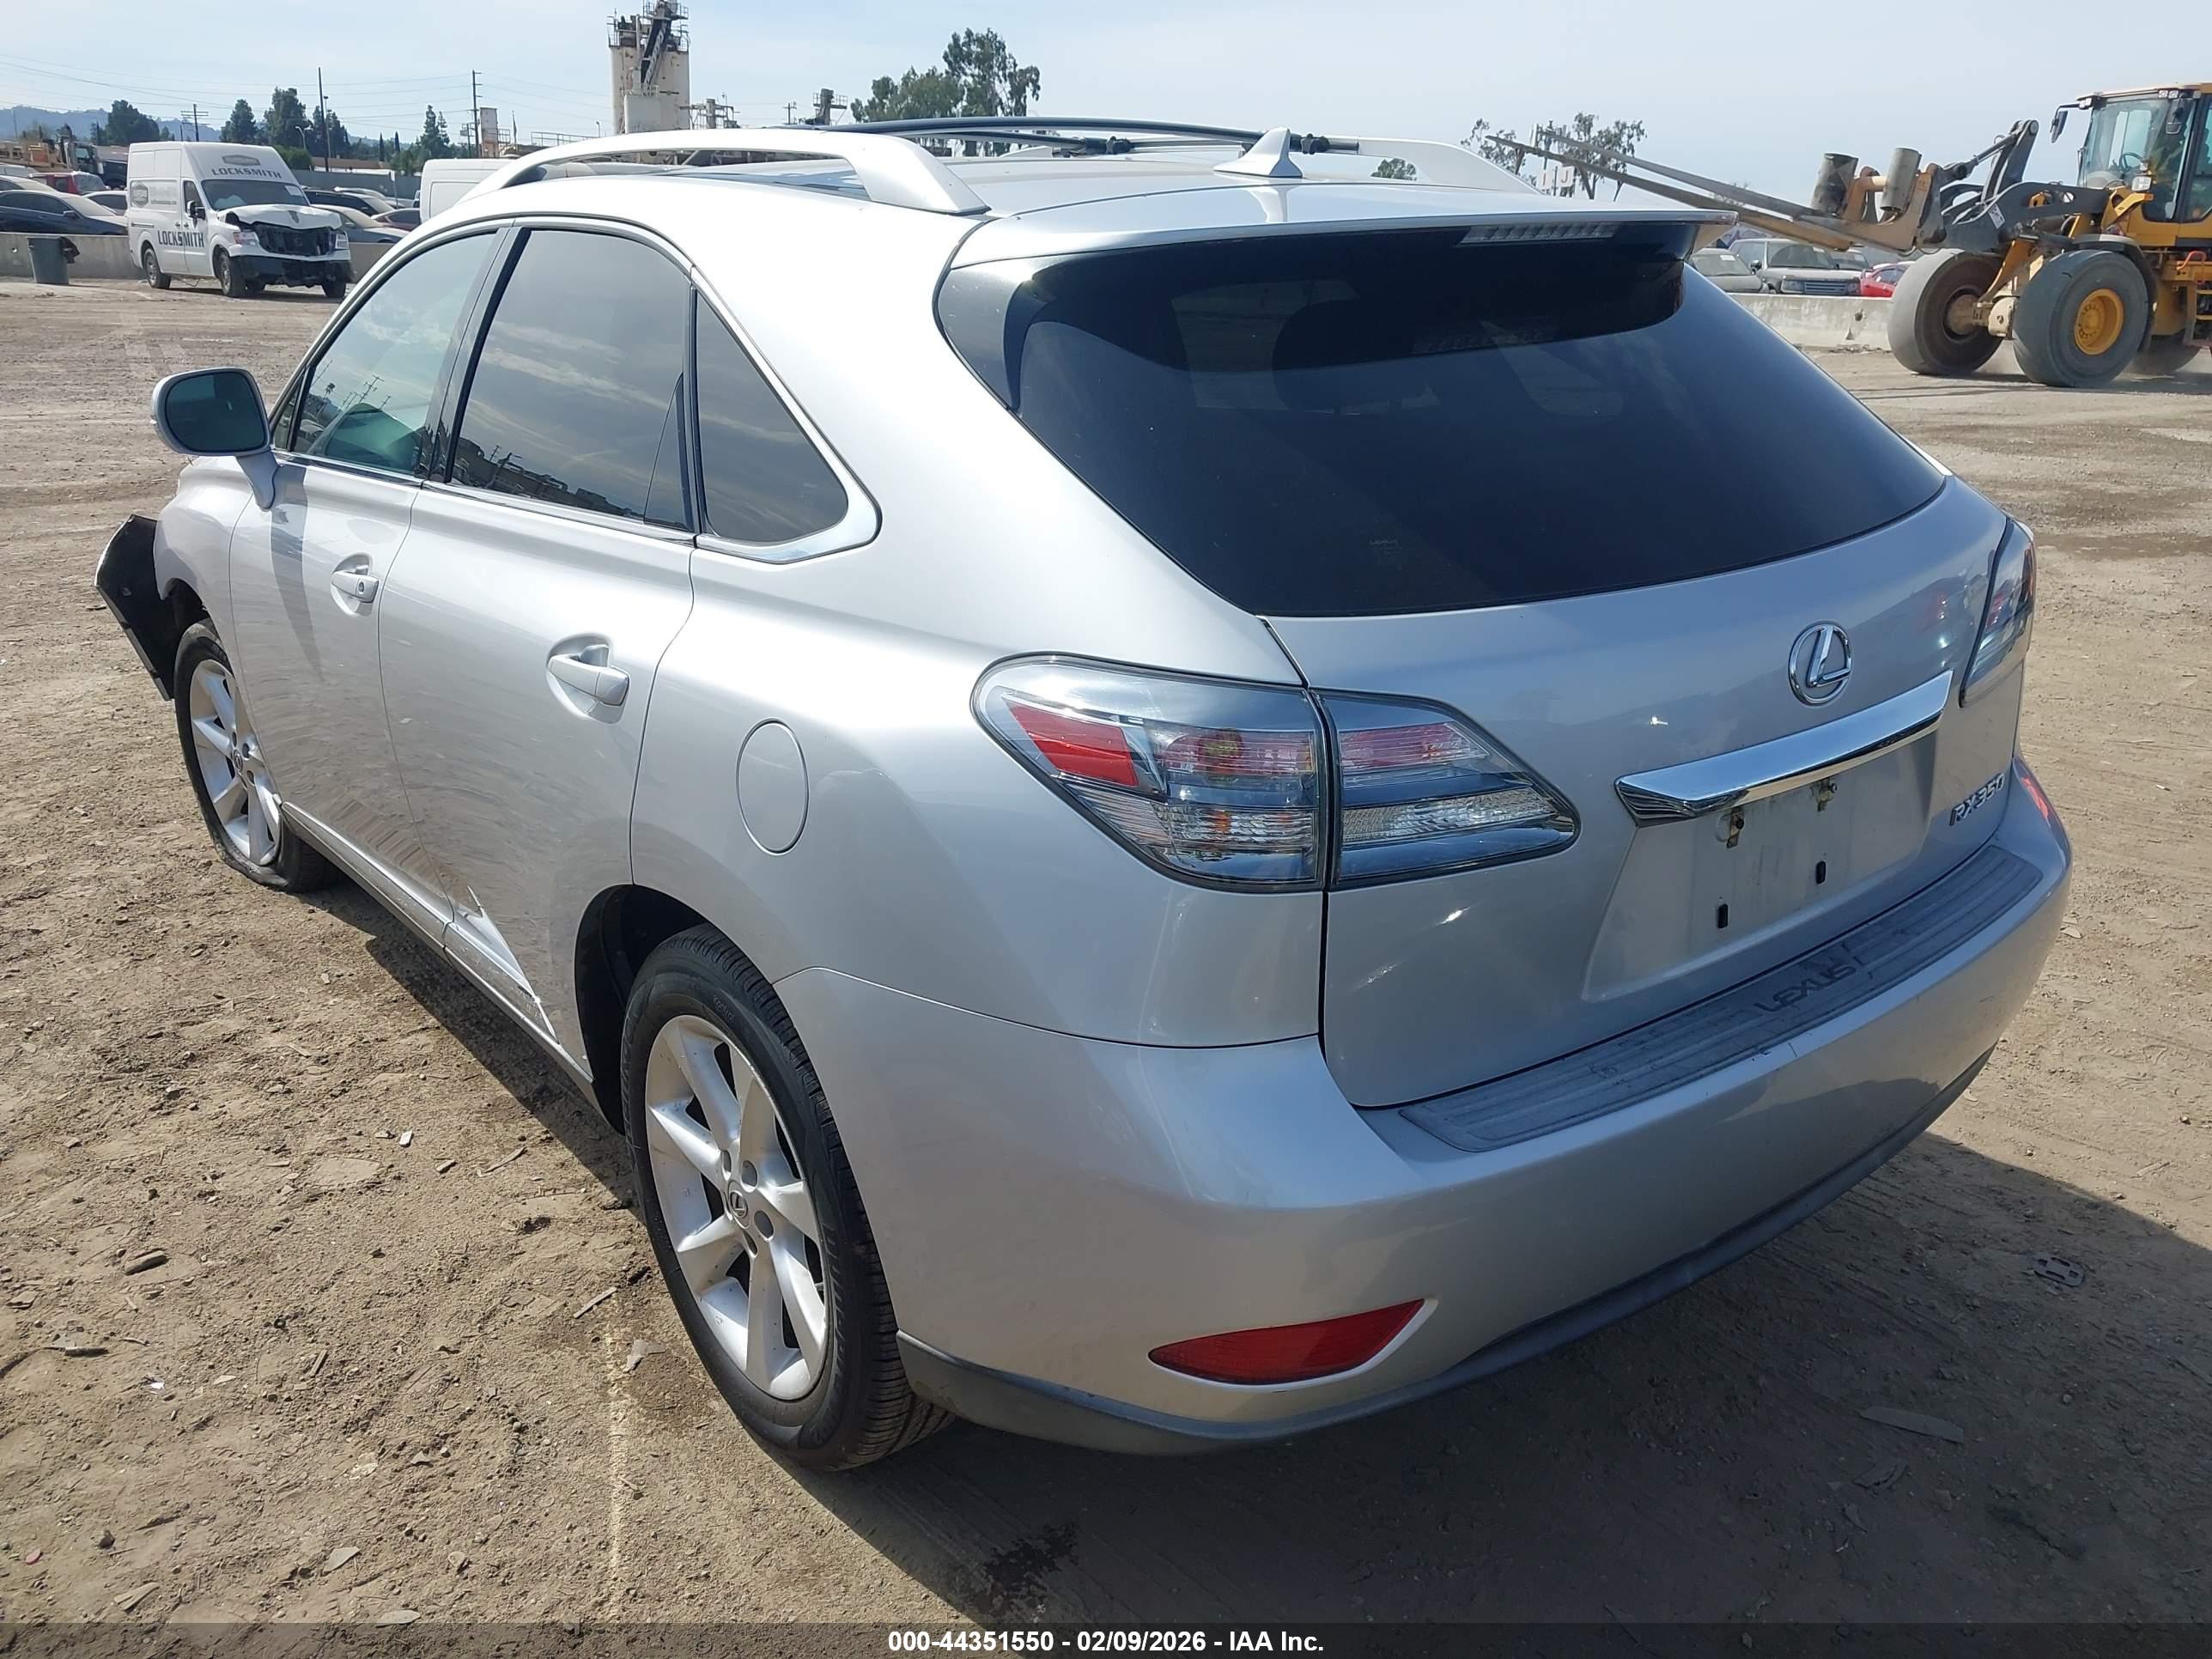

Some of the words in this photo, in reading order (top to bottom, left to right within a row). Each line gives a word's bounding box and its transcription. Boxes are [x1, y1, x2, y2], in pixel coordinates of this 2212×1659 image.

[211, 167, 282, 179] LOCKSMITH
[158, 230, 204, 247] LOCKSMITH
[1754, 963, 1856, 1012] LEXUS
